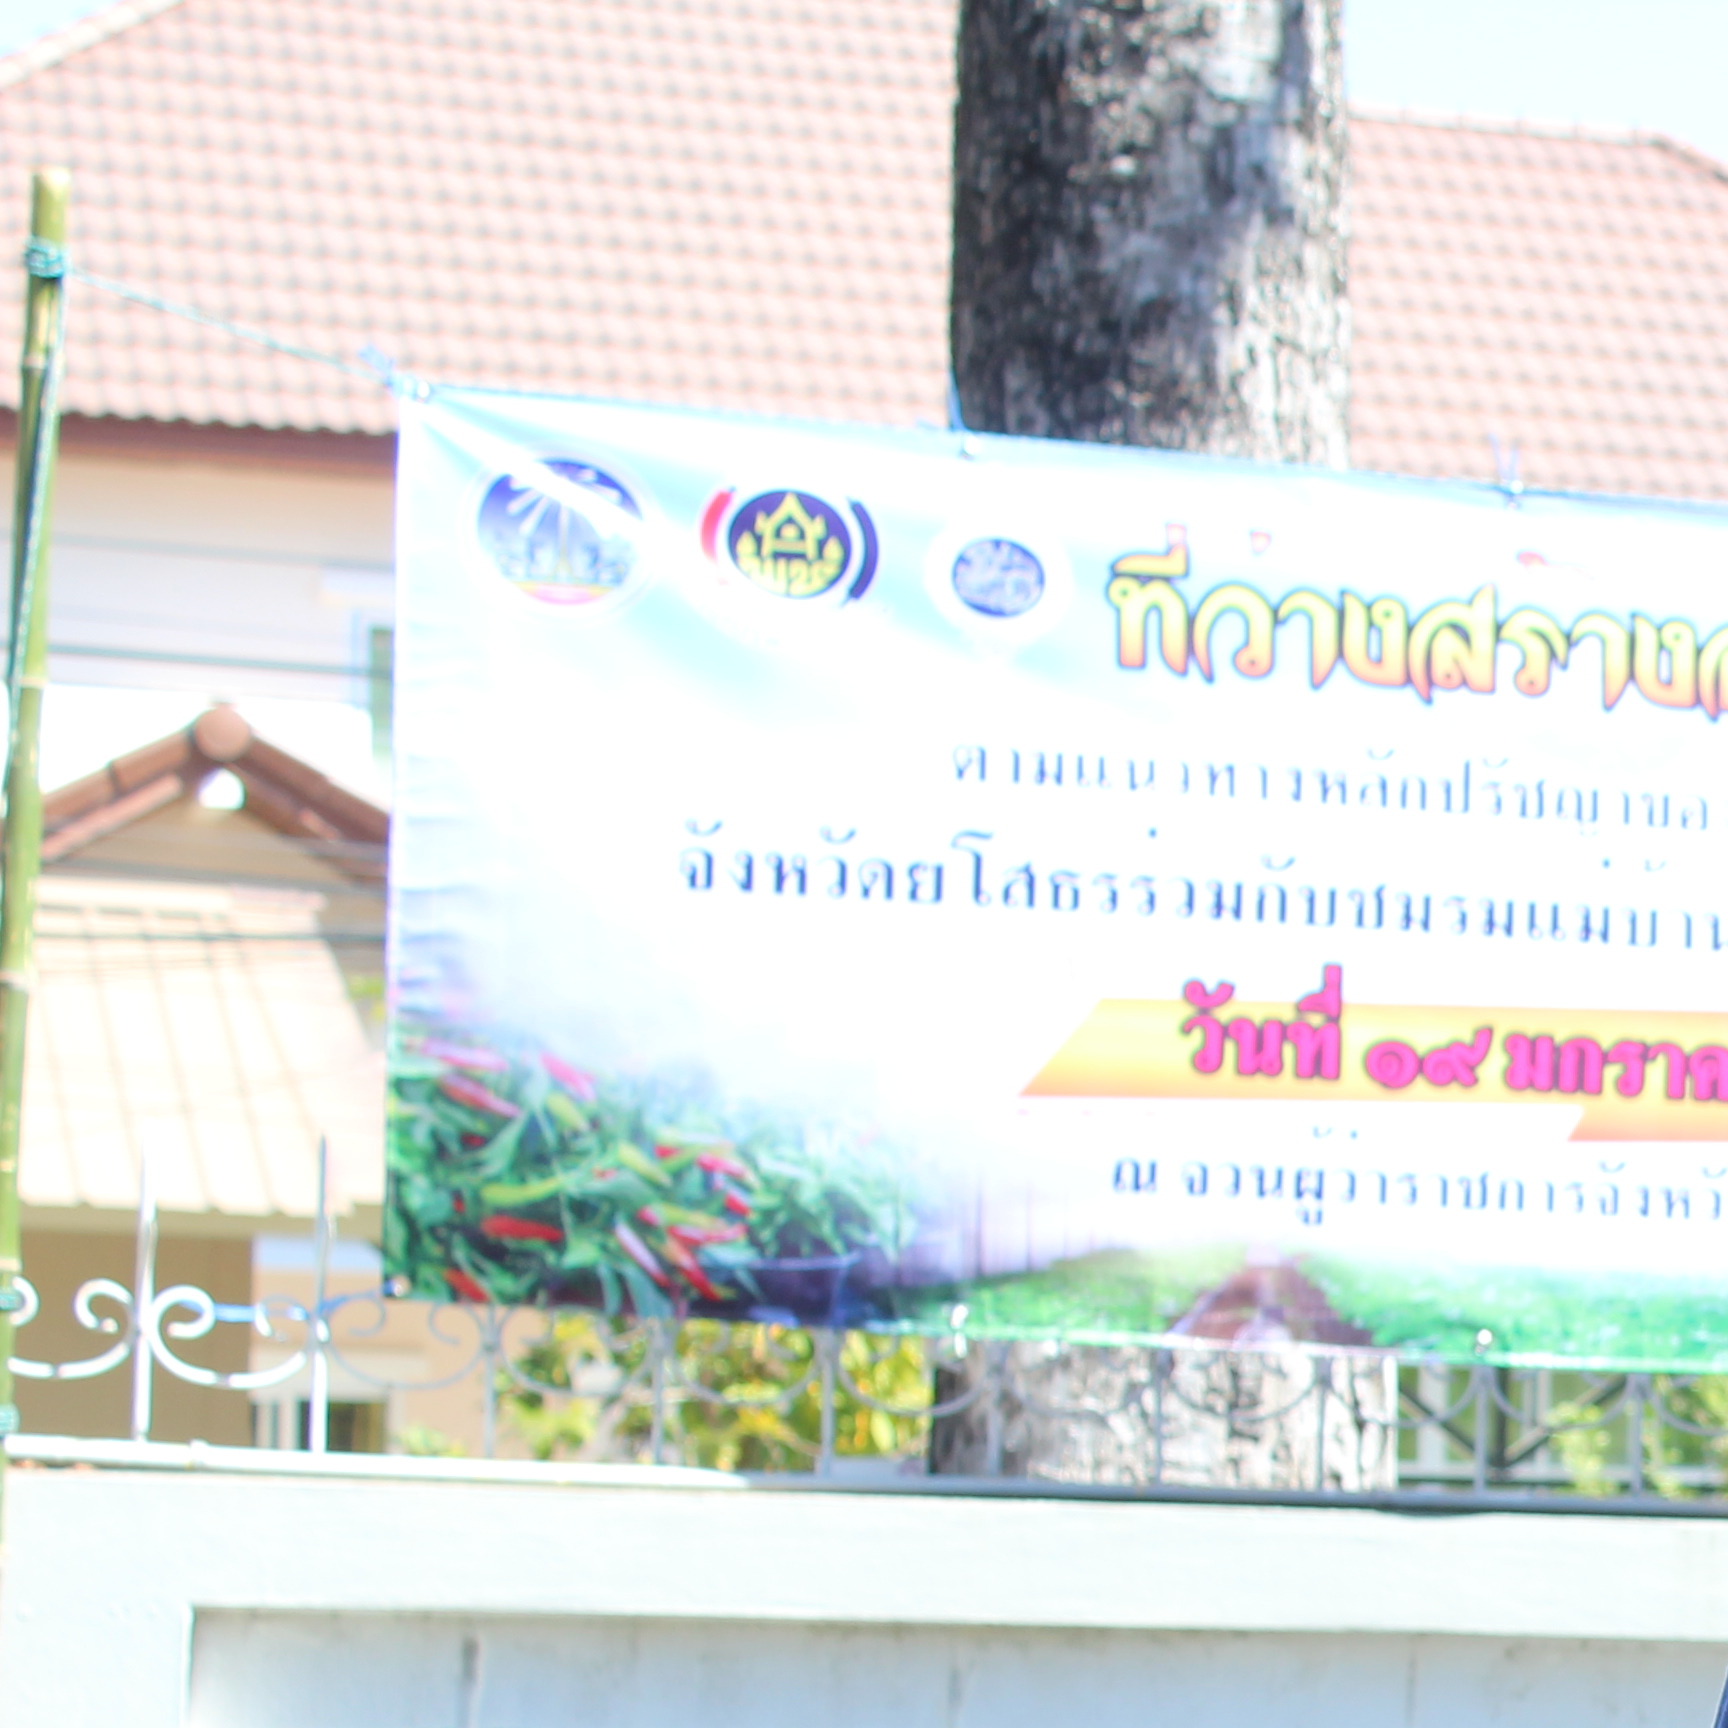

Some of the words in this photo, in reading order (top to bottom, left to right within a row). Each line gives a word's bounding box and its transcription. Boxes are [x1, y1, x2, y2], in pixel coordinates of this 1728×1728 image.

[1181, 963, 1345, 1081] วันที่
[1363, 1025, 1495, 1090] ๑๙
[1111, 1154, 1159, 1198] ณ
